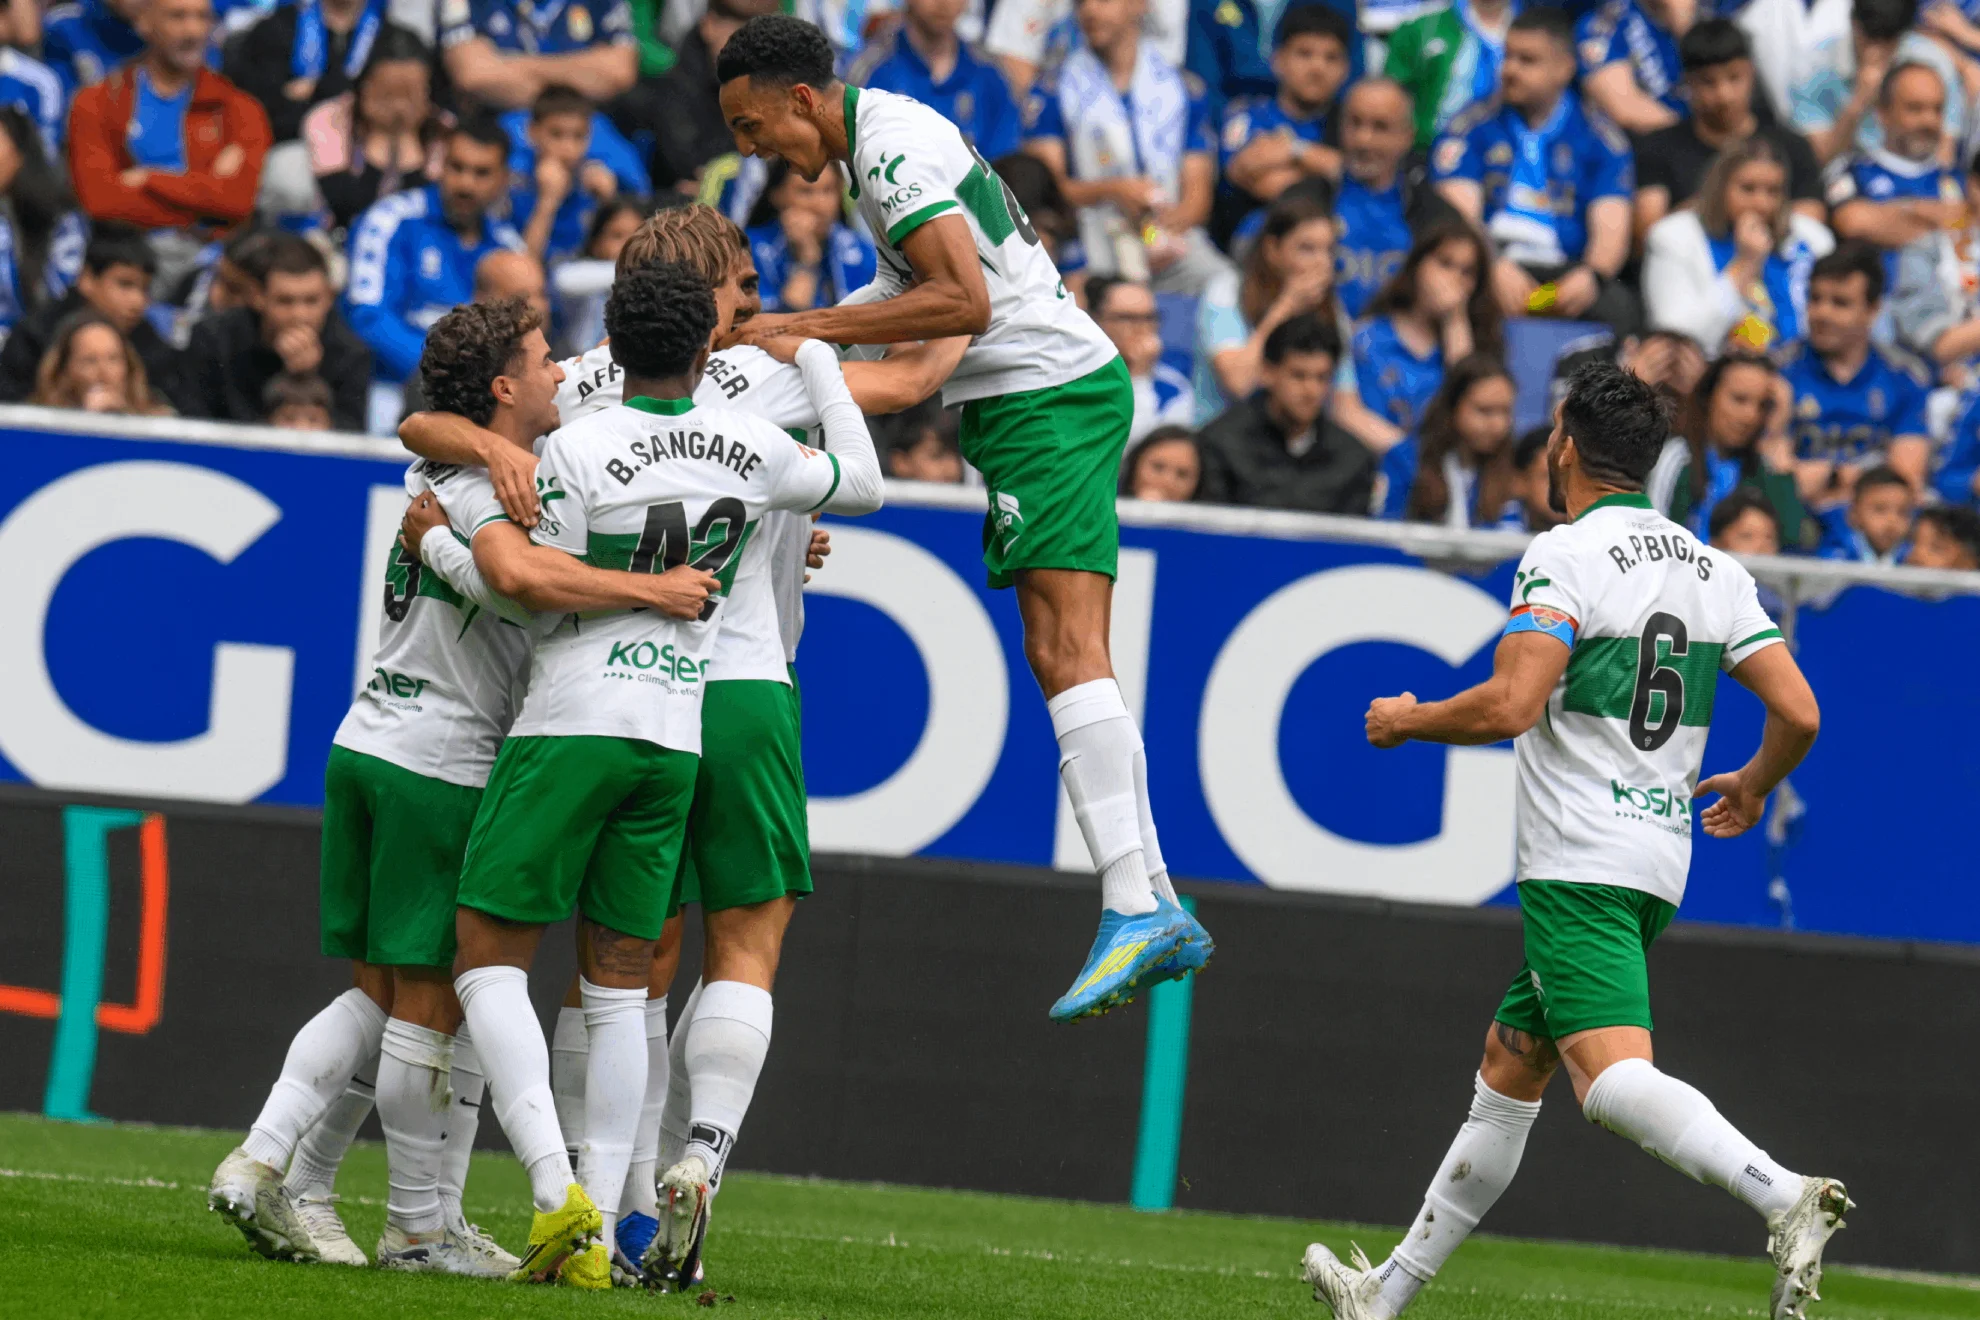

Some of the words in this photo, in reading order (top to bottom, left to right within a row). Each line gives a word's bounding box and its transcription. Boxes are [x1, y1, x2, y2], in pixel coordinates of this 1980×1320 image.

[881, 182, 923, 214] MGS
[628, 496, 747, 623] 42
[1629, 611, 1689, 752] 6
